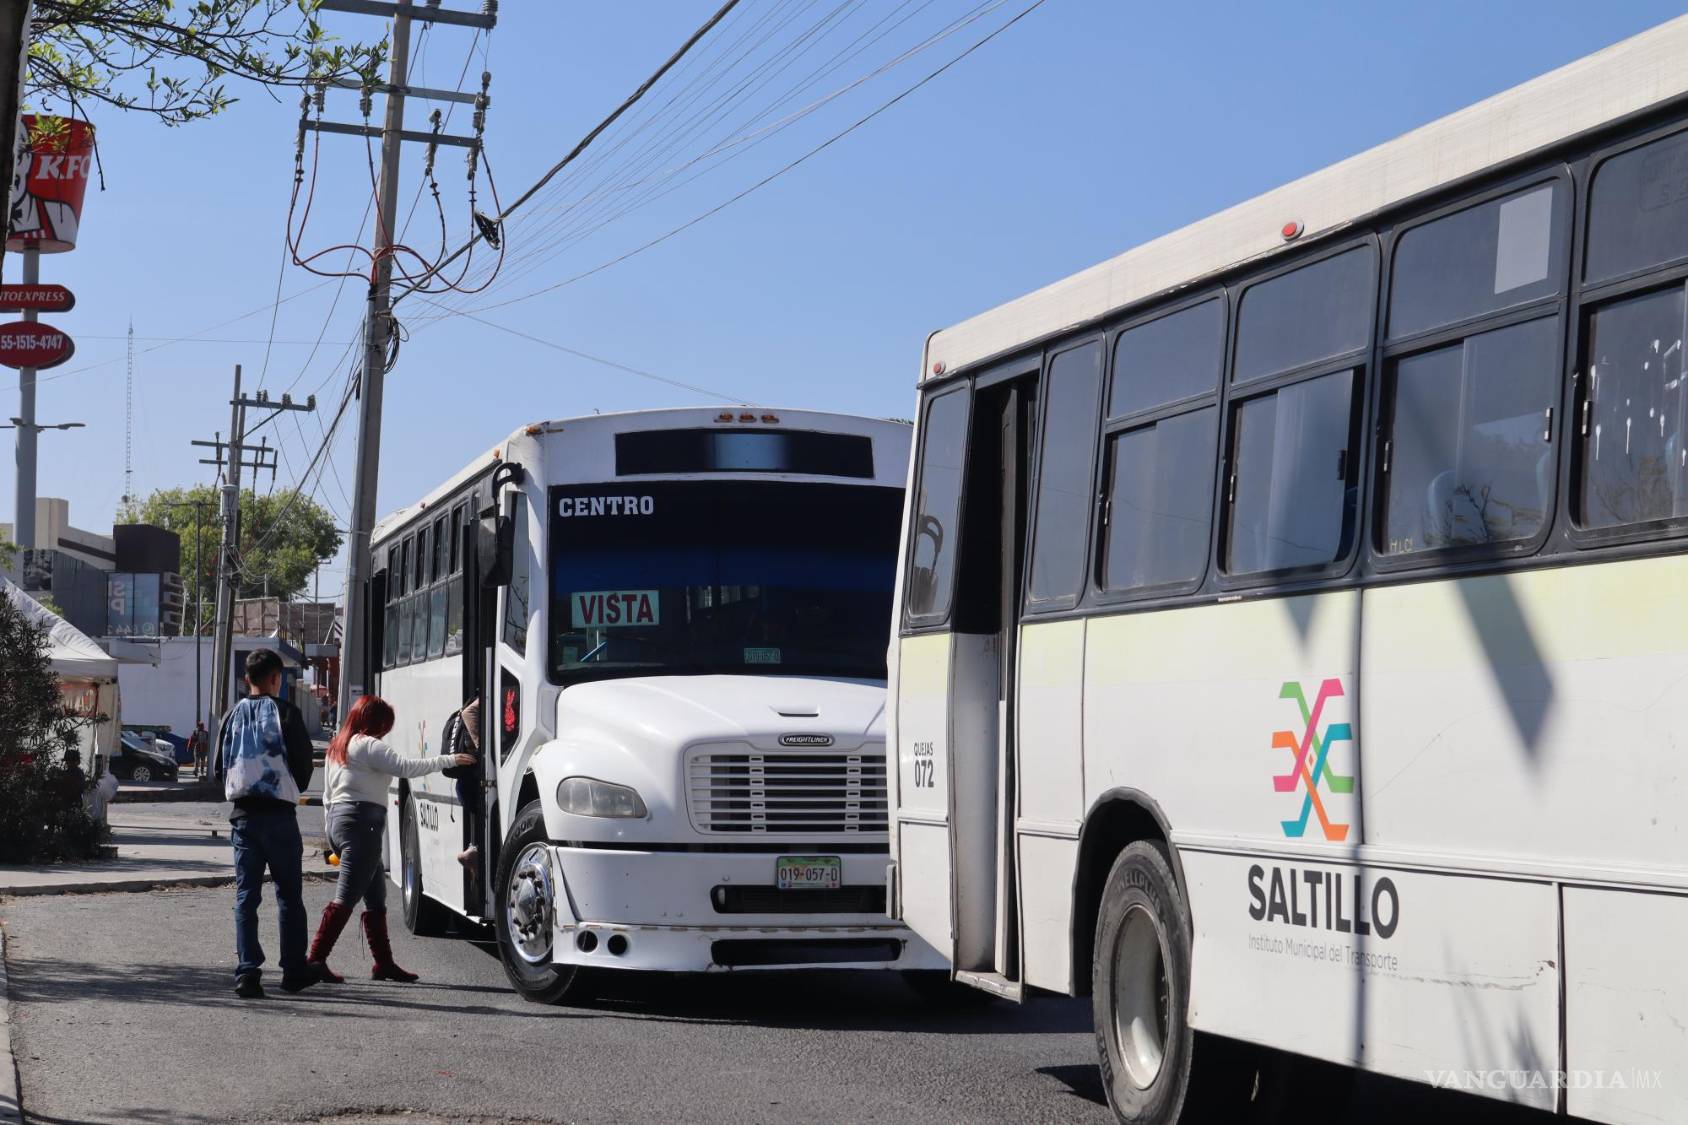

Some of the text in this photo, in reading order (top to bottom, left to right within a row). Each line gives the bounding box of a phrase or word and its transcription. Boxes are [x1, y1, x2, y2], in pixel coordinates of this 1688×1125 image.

[1, 335, 63, 349] 55-1515-4747
[559, 496, 654, 517] CENTRO
[579, 592, 654, 625] VISTA
[914, 742, 933, 756] QUEJAS
[915, 760, 934, 788] 072
[1248, 864, 1399, 939] SALTILLO
[1249, 935, 1398, 971] Instituto Municipal del Transporte
